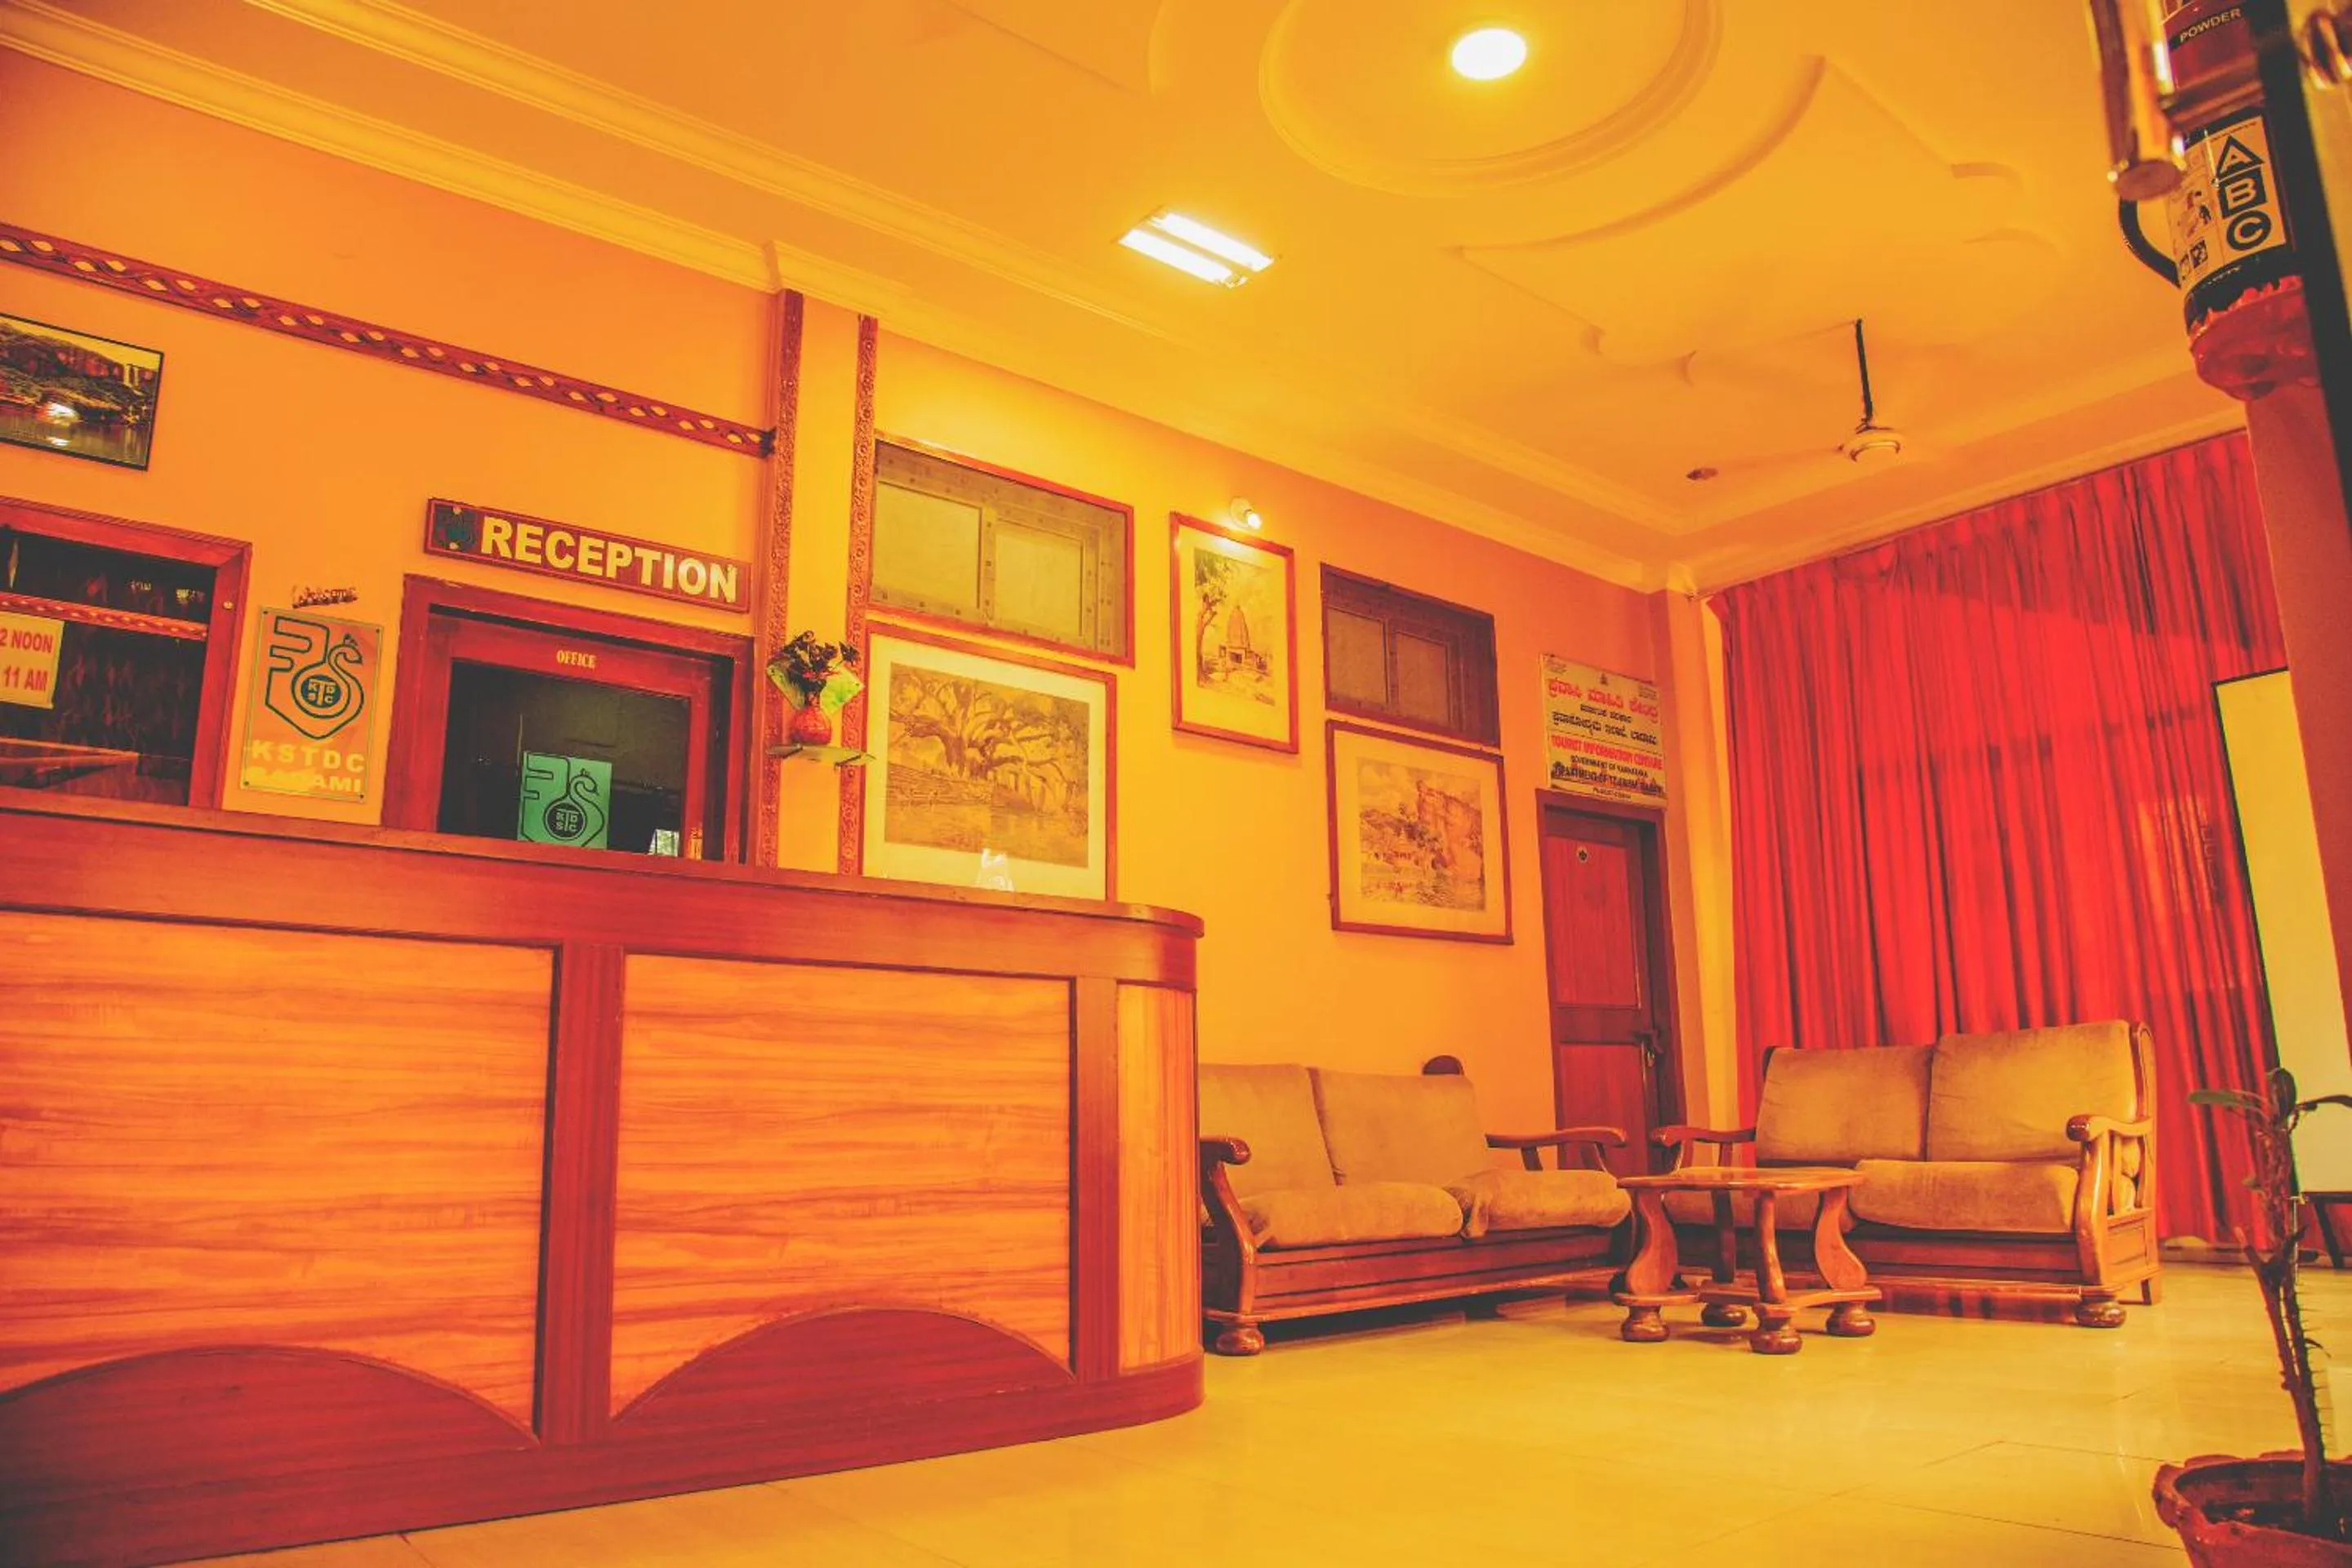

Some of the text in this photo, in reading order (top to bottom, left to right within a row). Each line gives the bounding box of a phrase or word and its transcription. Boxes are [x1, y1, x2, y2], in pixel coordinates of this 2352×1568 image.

[2180, 8, 2241, 42] POWDER
[2224, 178, 2257, 210] B
[2234, 216, 2264, 244] C
[480, 515, 738, 604] RECEPTION
[11, 630, 53, 653] NOON
[556, 650, 596, 669] OFFICE
[4, 666, 48, 692] 11 AM
[252, 739, 365, 773] KSTDC
